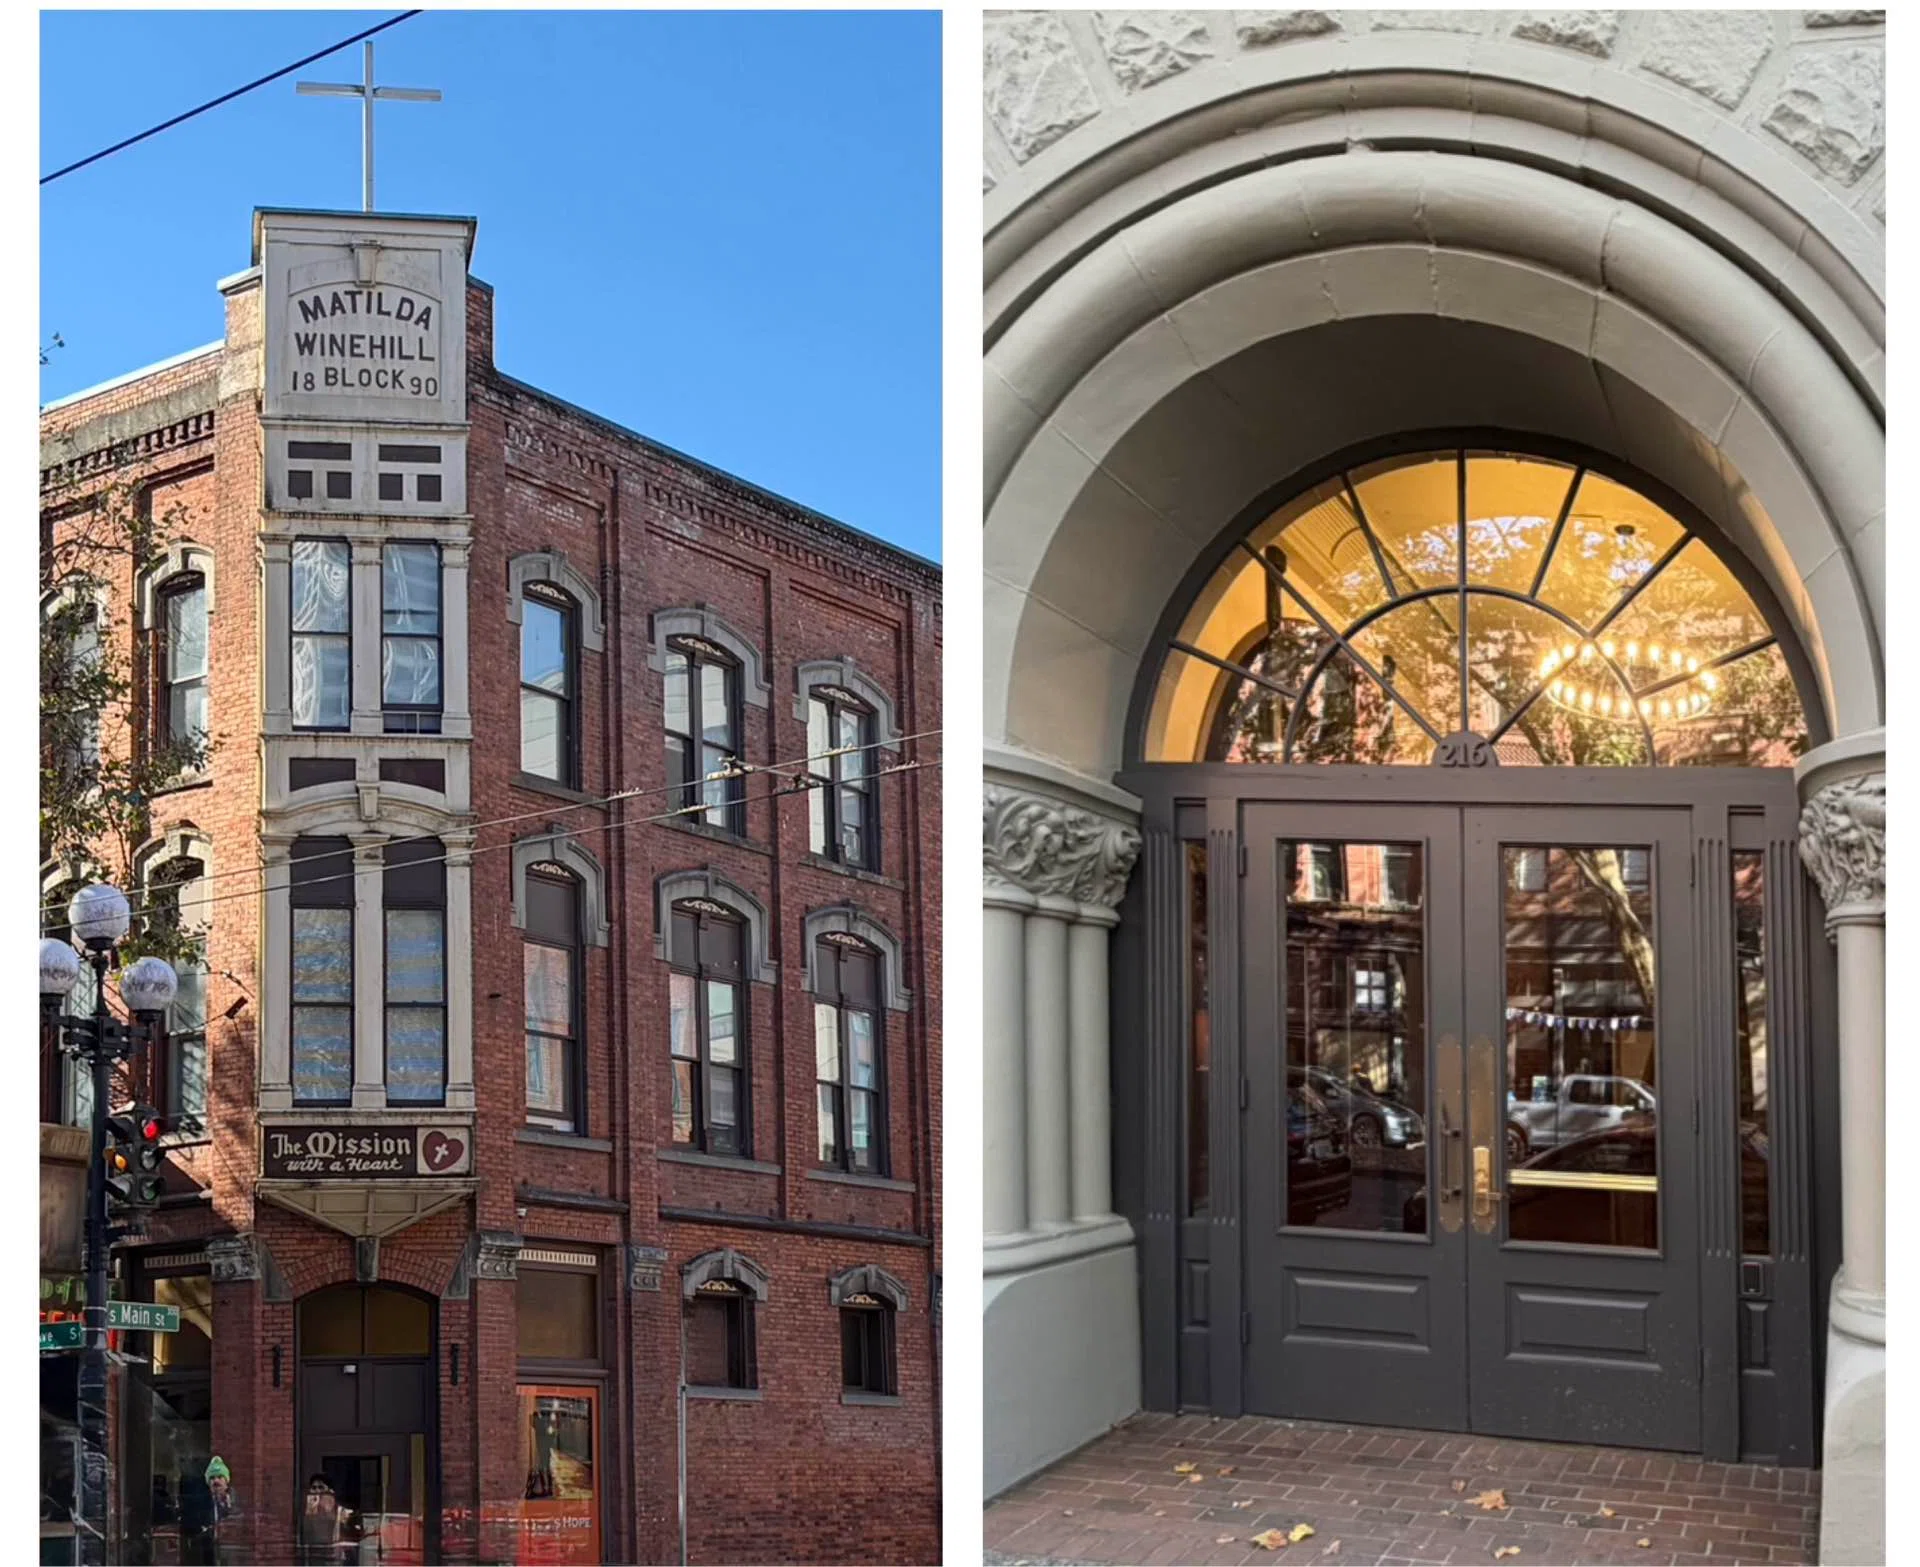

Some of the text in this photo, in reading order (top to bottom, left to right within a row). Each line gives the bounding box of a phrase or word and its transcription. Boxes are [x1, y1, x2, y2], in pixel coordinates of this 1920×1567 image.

[298, 290, 432, 331] MATILDA
[295, 332, 436, 362] WINEHILL
[292, 367, 438, 397] 18 BLOCK 90
[1440, 742, 1488, 768] 216
[270, 1130, 412, 1159] The Mission
[283, 1157, 403, 1172] with a Heart
[121, 1304, 150, 1326] Main
[154, 1312, 165, 1327] St
